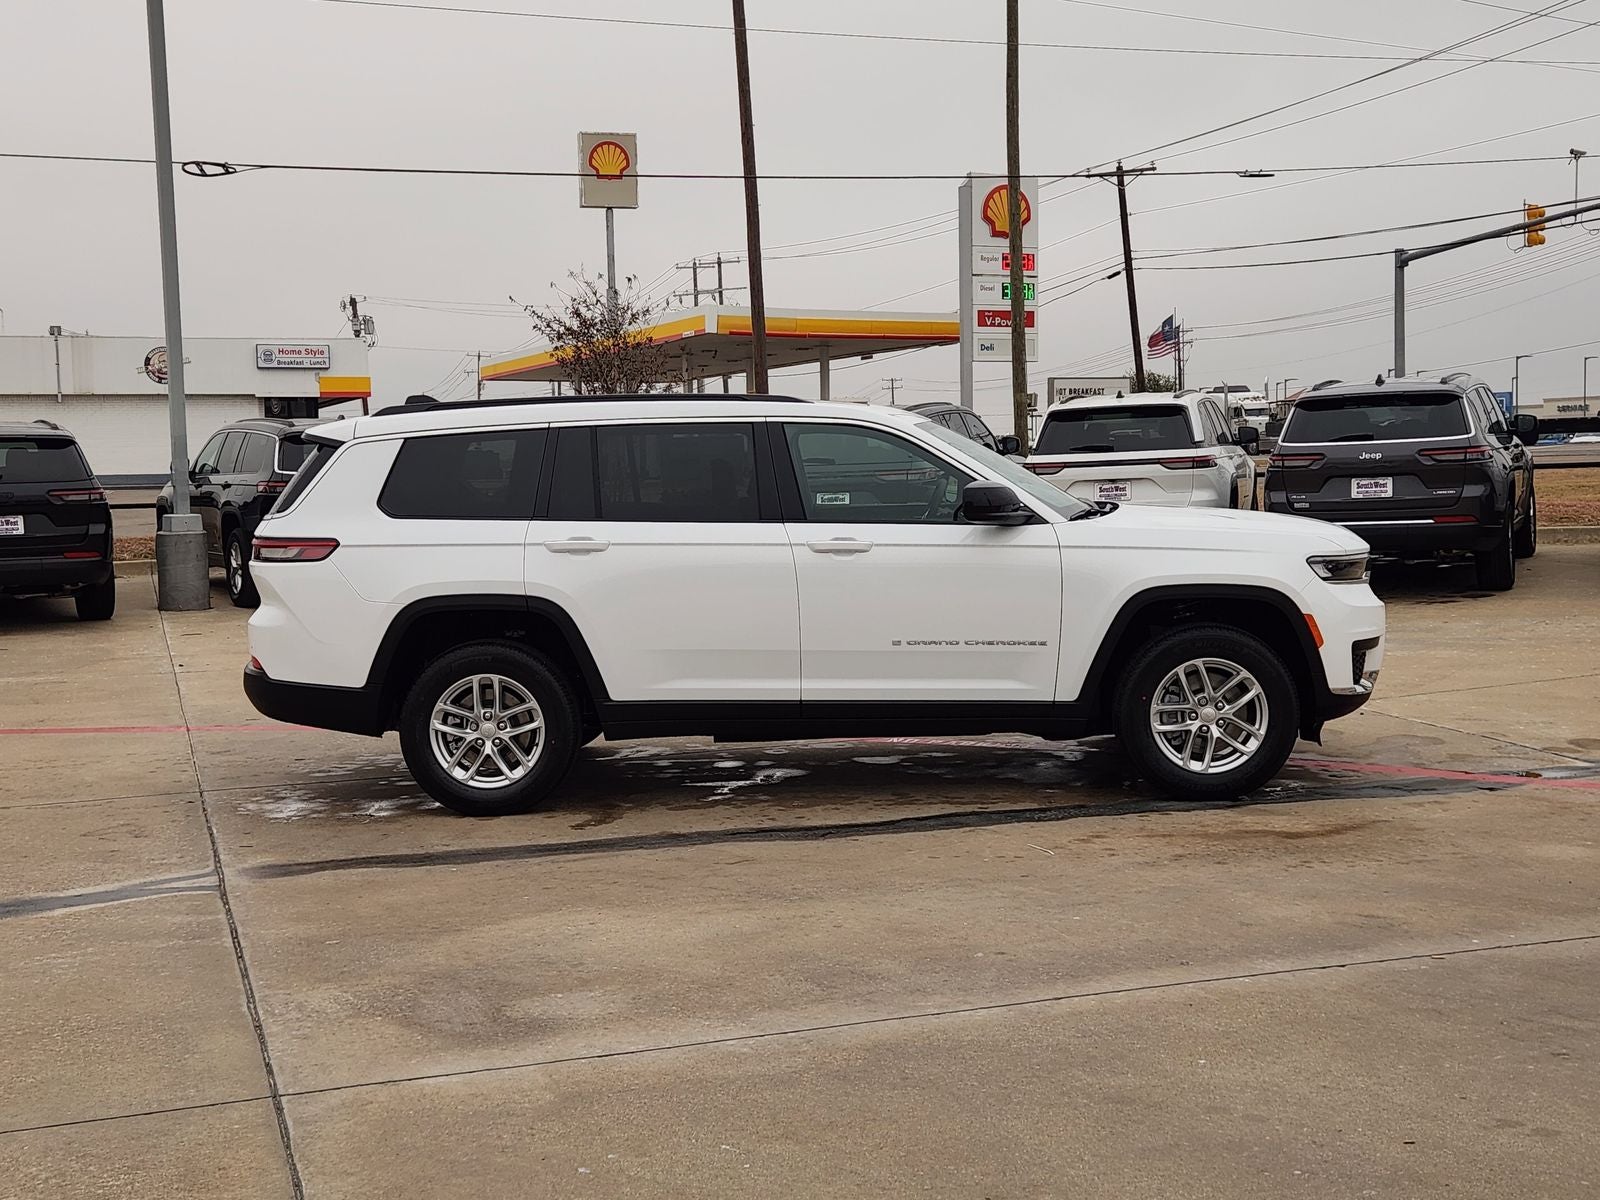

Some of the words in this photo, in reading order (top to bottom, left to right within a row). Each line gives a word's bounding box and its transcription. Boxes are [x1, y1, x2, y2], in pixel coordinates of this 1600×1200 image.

[980, 254, 1000, 263] Regular
[980, 284, 995, 292] Diesel
[980, 343, 994, 351] Deli
[278, 347, 302, 356] Home
[304, 347, 325, 357] Style
[276, 358, 305, 366] Breakfast
[1068, 387, 1105, 396] BREAKFAST
[1359, 451, 1382, 460] Jeep
